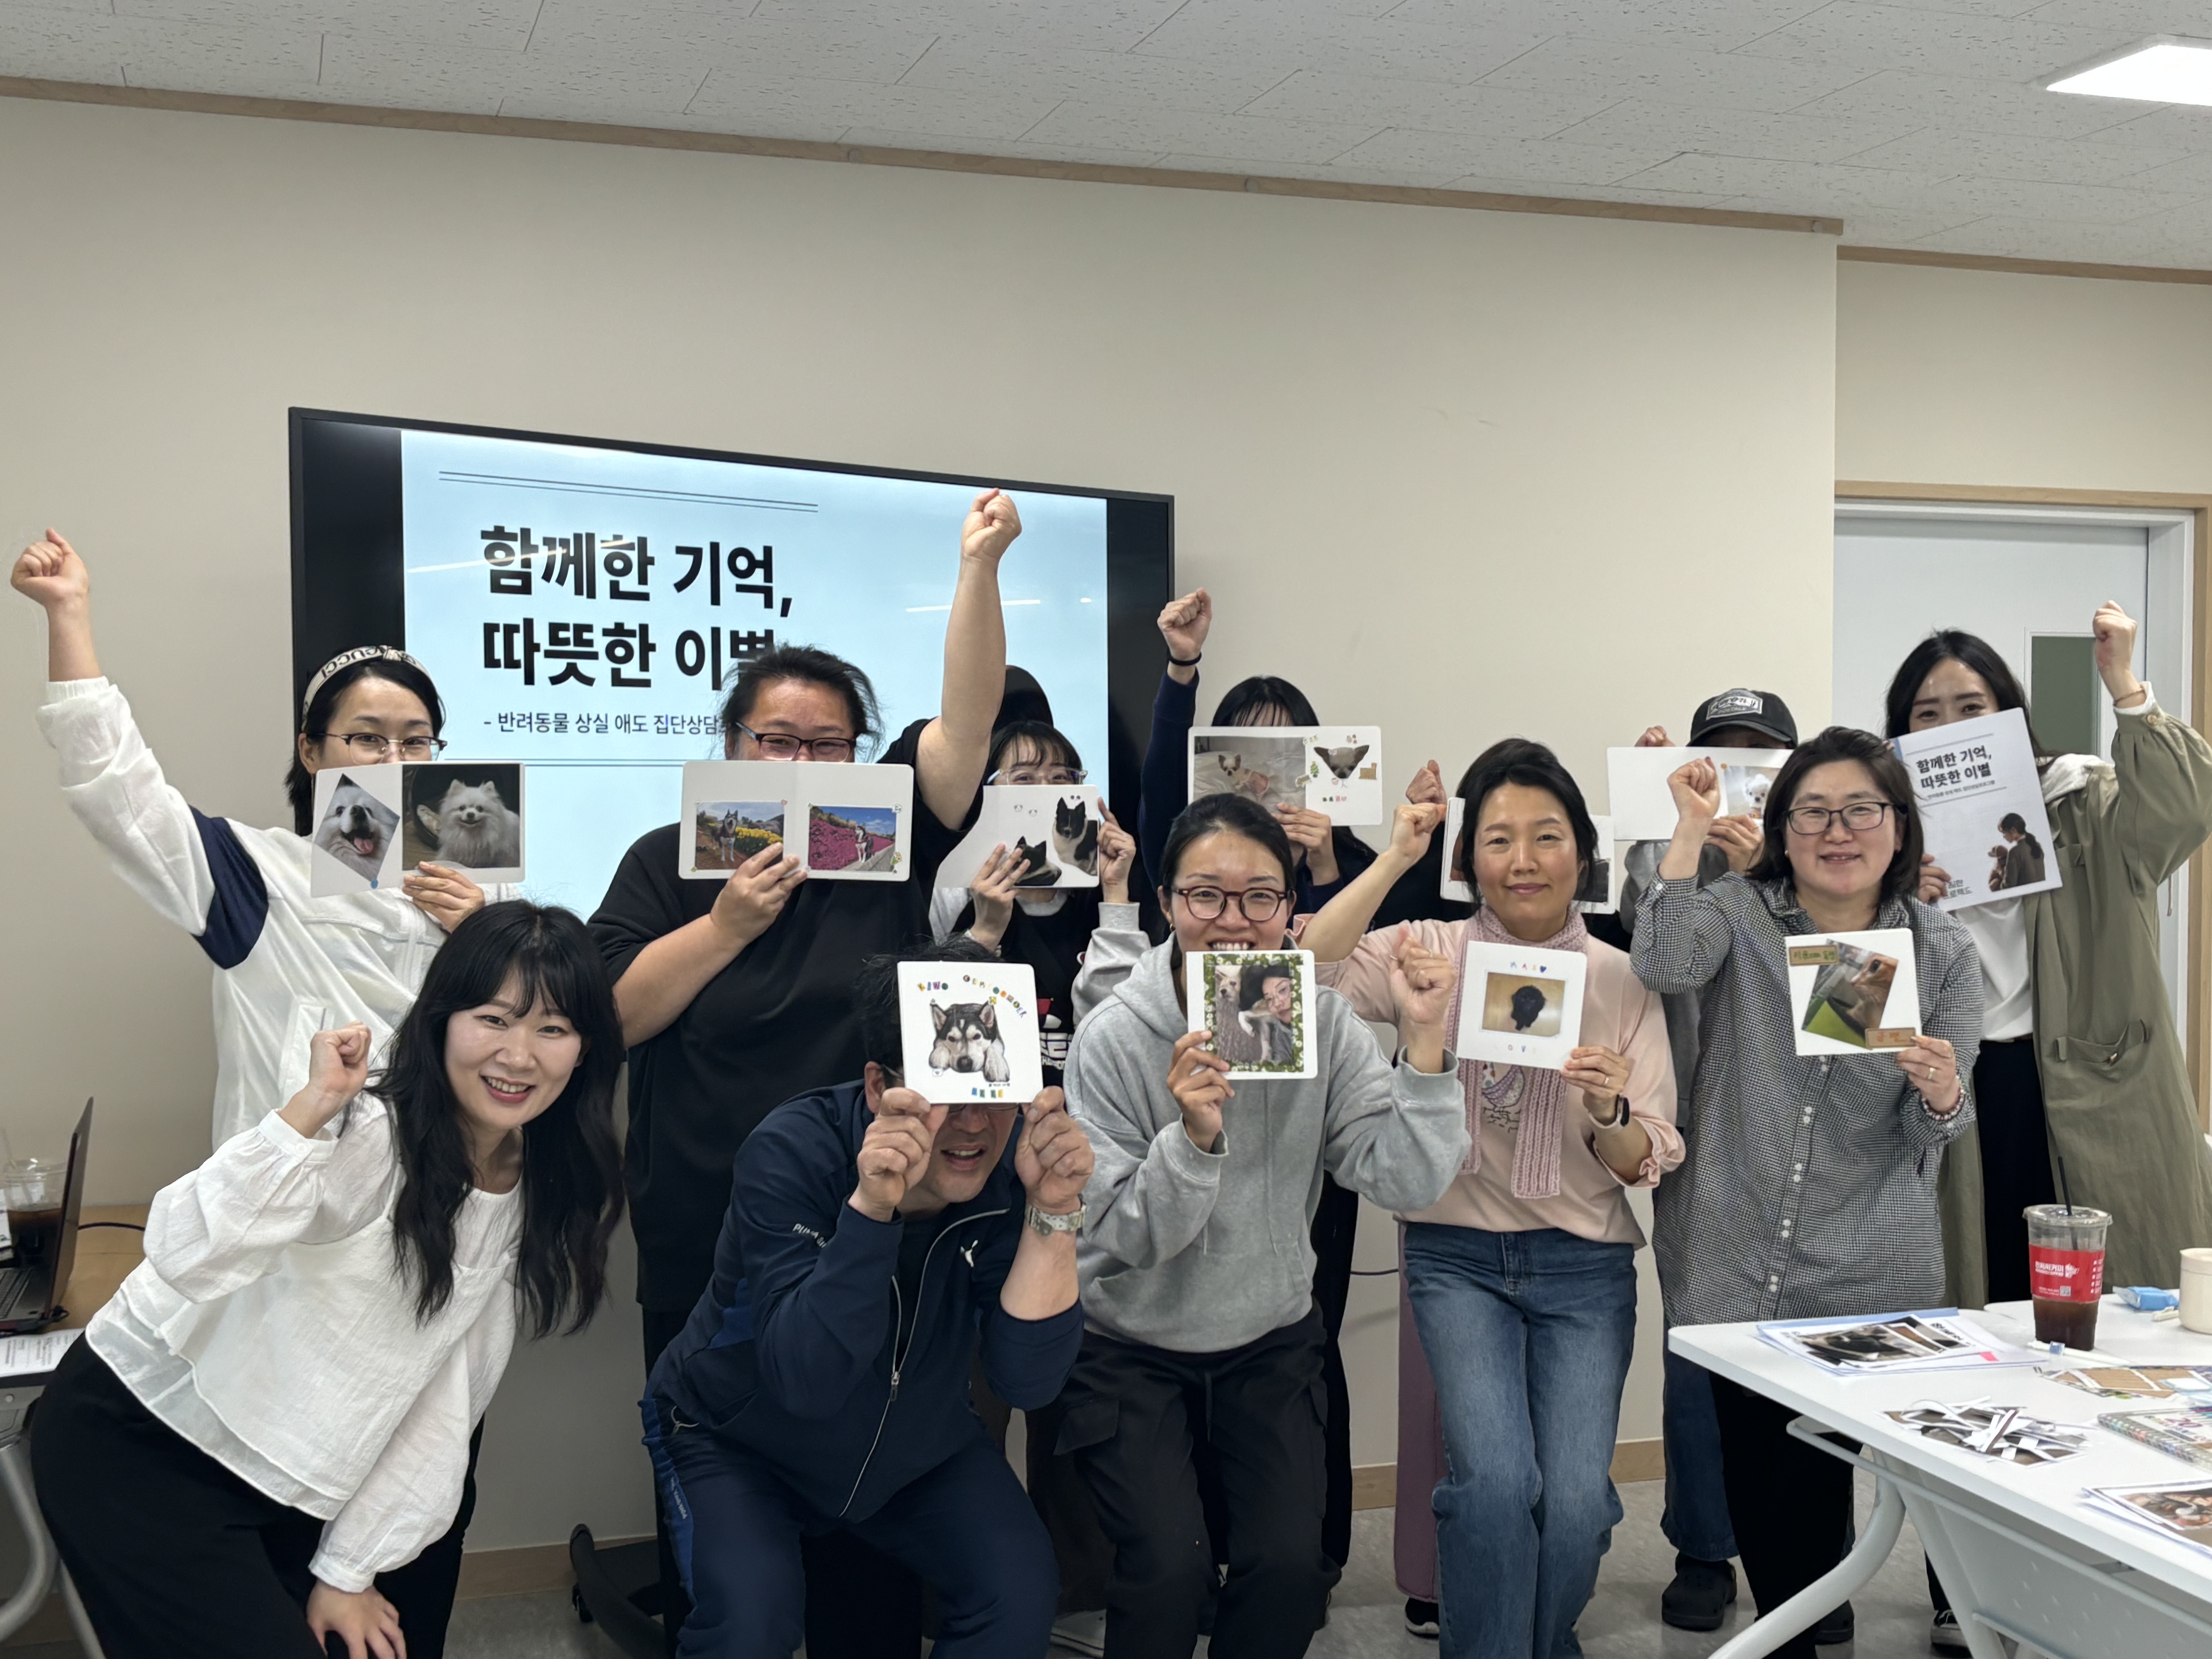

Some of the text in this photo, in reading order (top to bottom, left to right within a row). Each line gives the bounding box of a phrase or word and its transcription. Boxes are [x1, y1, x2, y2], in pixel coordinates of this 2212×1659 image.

[480, 525, 792, 618] 함께한 기억,
[483, 618, 656, 687] 따뜻한
[498, 712, 570, 733] 반려동물
[575, 713, 609, 733] 상실
[615, 714, 648, 734] 애도
[653, 714, 726, 735] 집단상담
[1915, 745, 1992, 774] 함께한 기억,
[1921, 762, 1992, 789] 따뜻한 이별
[793, 1223, 819, 1239] PUMA
